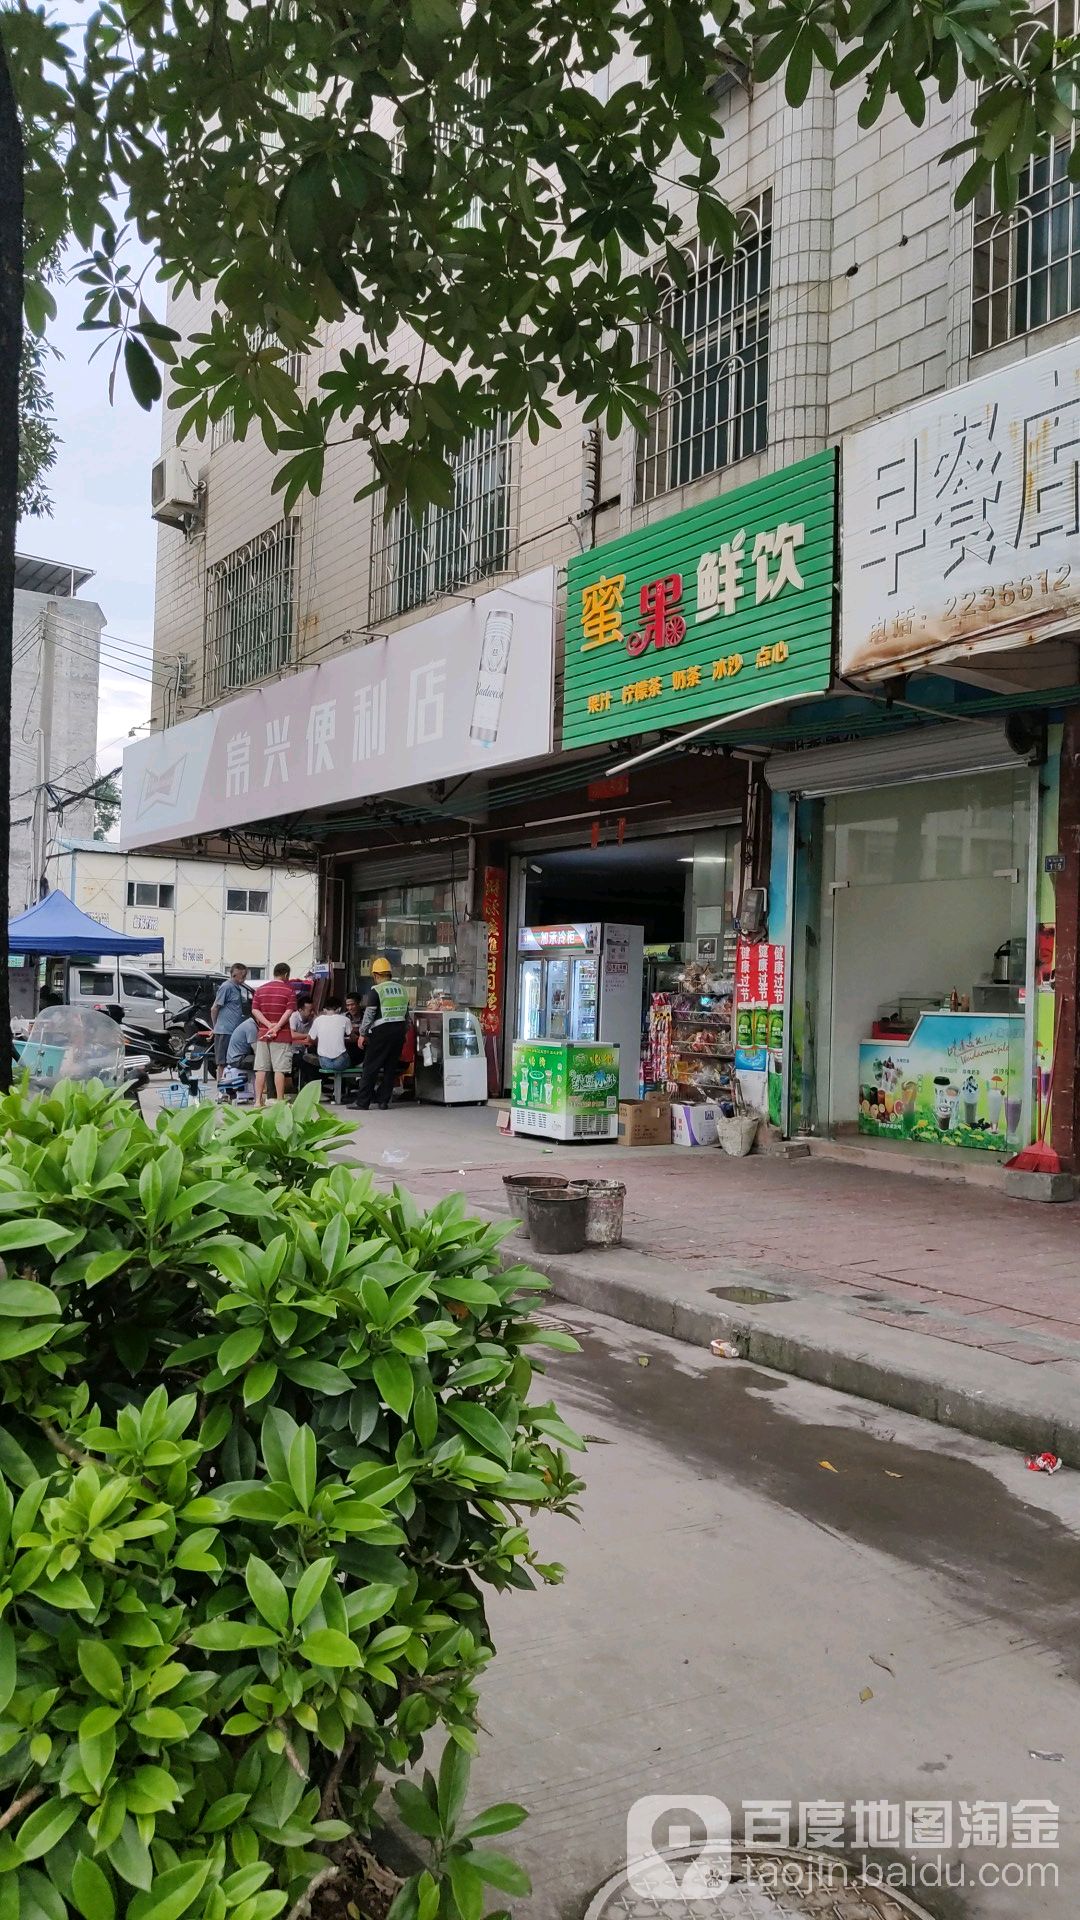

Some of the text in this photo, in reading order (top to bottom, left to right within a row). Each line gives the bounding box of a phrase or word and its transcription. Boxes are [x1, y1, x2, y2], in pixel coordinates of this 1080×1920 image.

[860, 369, 1080, 597] 早餐店
[580, 522, 805, 657] 蜜果鲜饮
[943, 563, 1071, 622] 2236612
[587, 640, 789, 714] 果汁 柠檬茶 奶茶 冰沙 点心
[225, 657, 448, 799] 常兴便利店
[738, 946, 750, 1002] 健康过节
[758, 945, 769, 1000] 健康过节
[774, 946, 784, 1003] 健康过节
